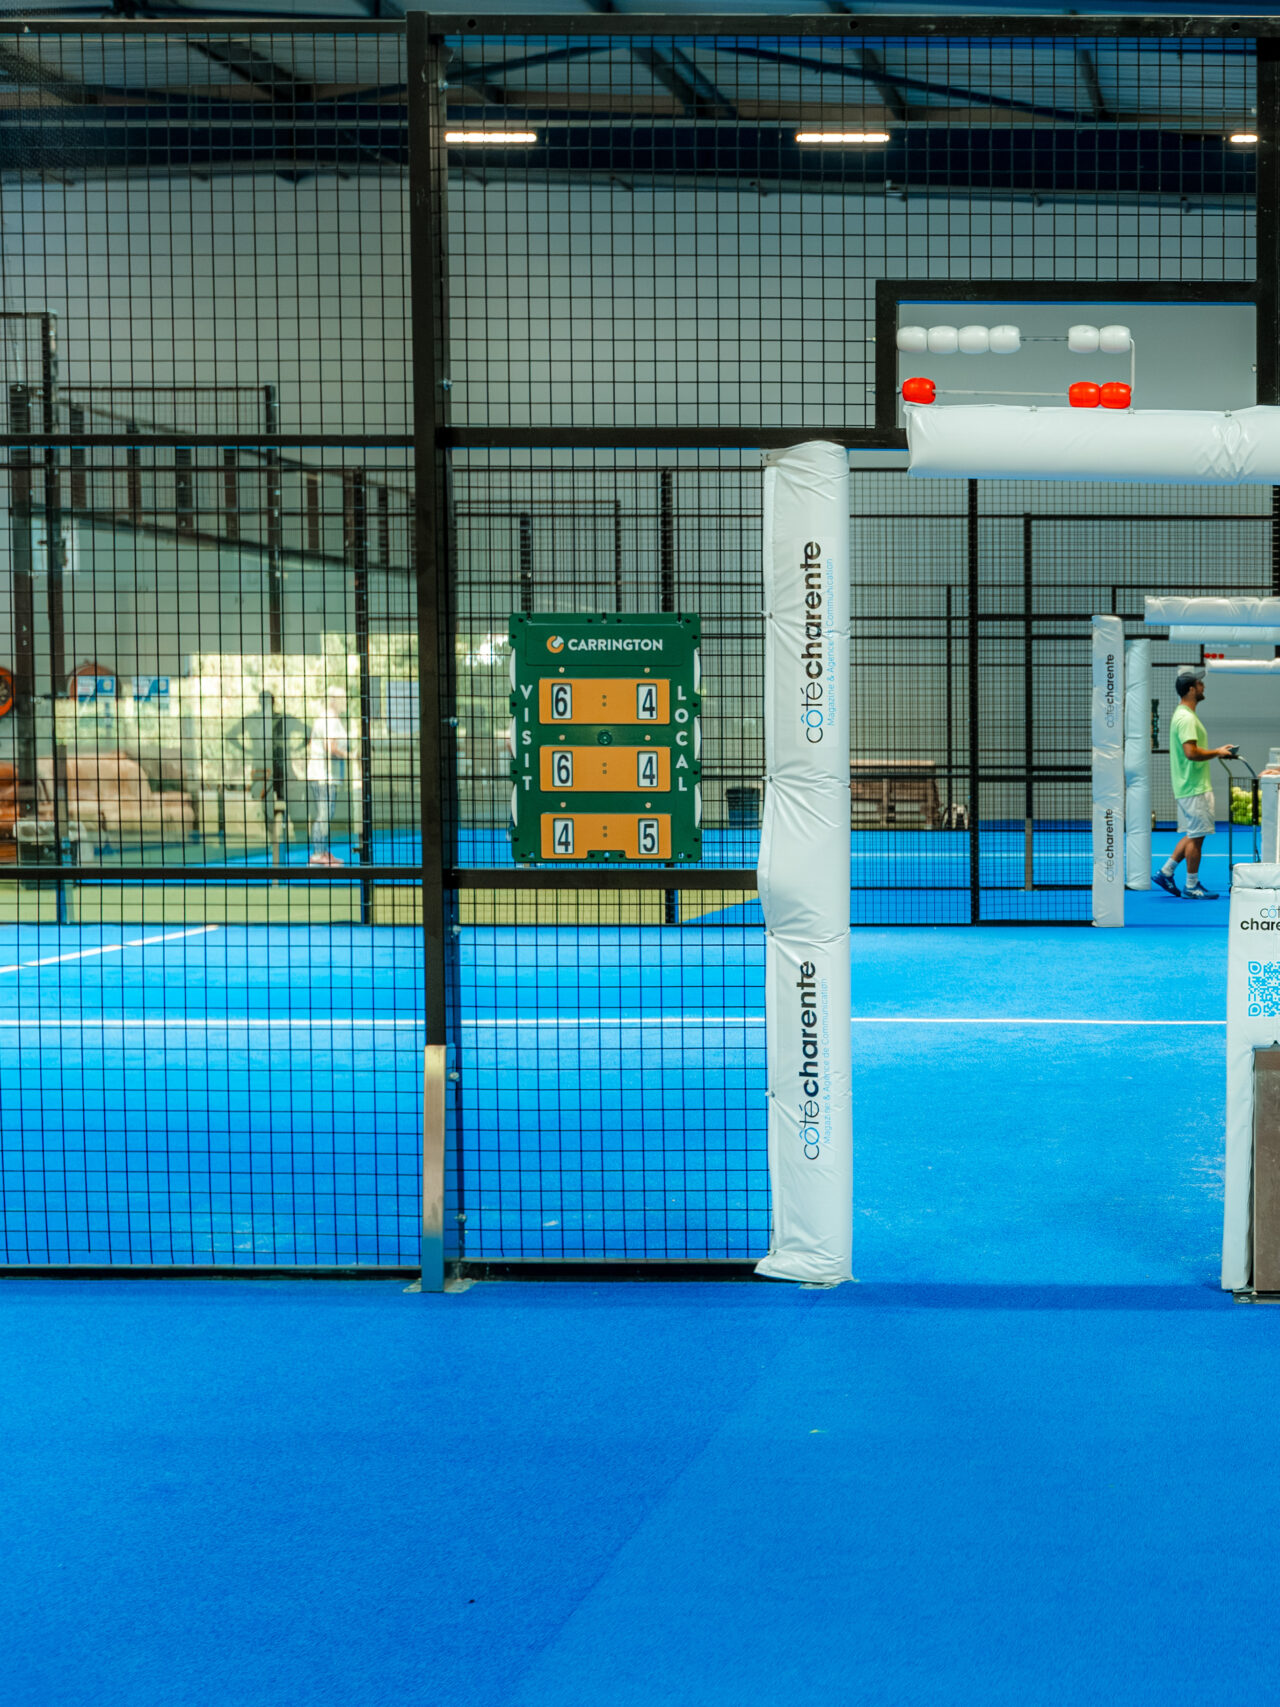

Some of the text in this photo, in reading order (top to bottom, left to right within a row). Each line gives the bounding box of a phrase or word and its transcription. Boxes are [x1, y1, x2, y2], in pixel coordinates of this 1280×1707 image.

[826, 558, 834, 627] Communication
[568, 638, 663, 651] CARRINGTON
[827, 641, 835, 673] Agence
[554, 686, 656, 718] 6 4
[827, 684, 836, 726] Magazine
[520, 685, 533, 791] VISIT
[675, 685, 689, 791] LOCAL
[556, 754, 656, 785] 6 4
[557, 823, 656, 852] 4 5
[821, 978, 829, 1045] Communication
[823, 1048, 830, 1058] de
[822, 1061, 831, 1092] Agence
[823, 1103, 832, 1144] Magazine
